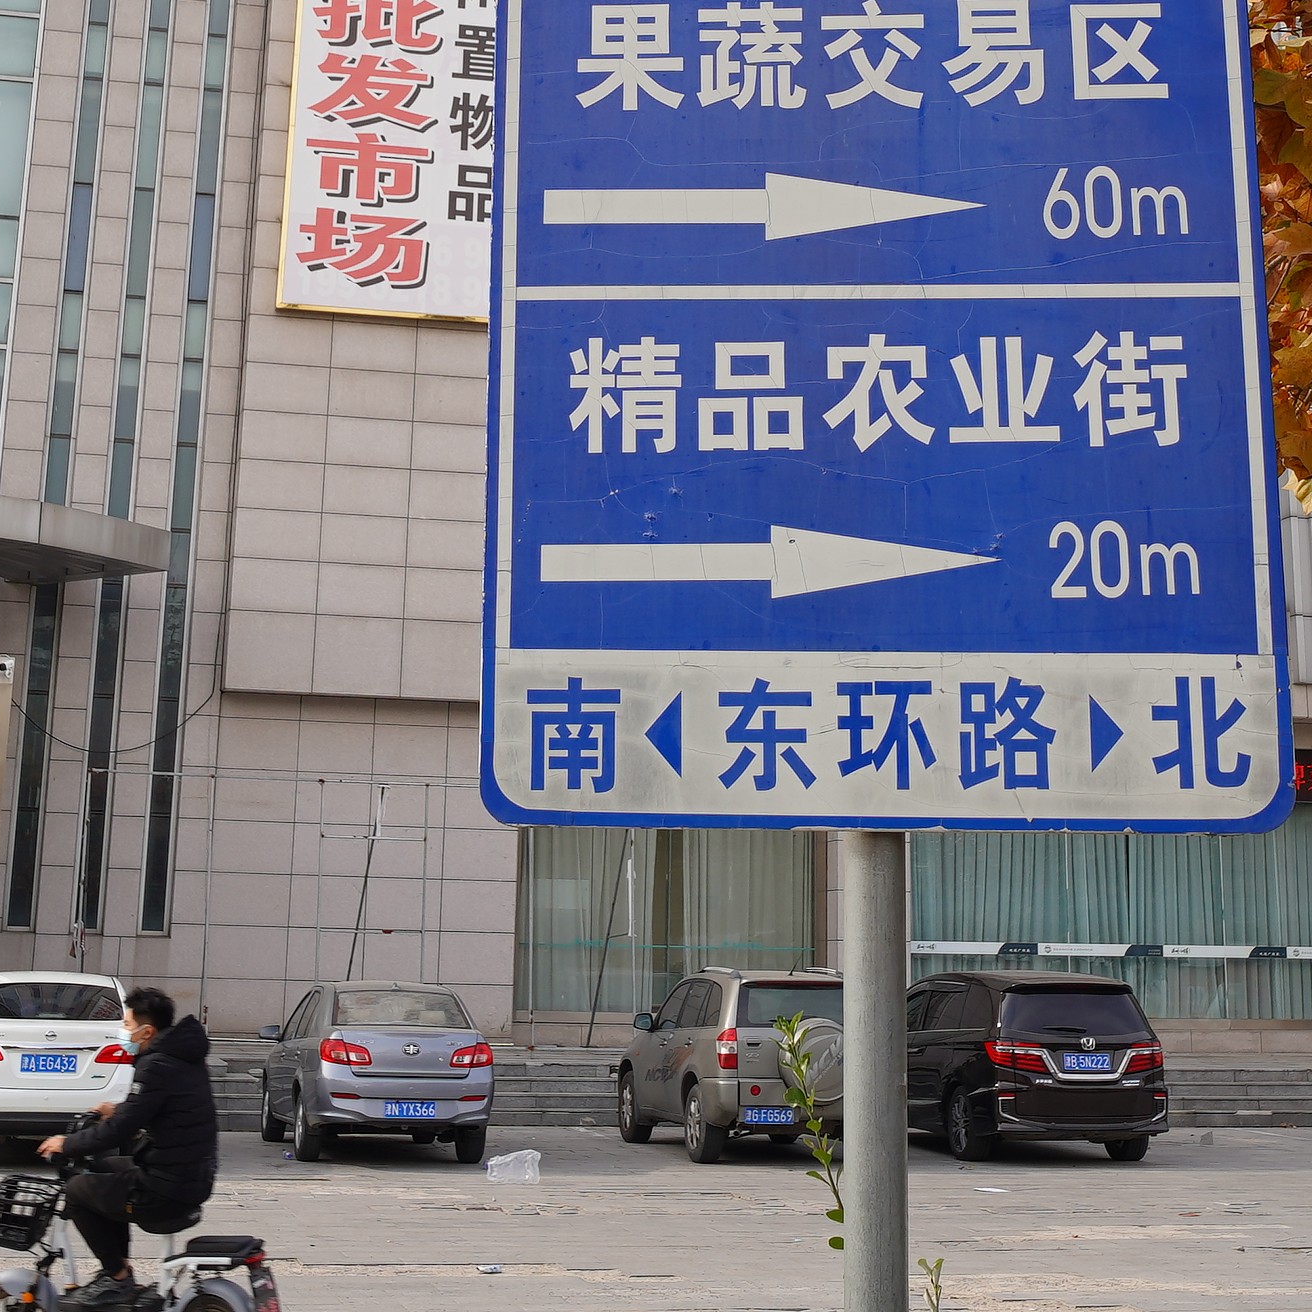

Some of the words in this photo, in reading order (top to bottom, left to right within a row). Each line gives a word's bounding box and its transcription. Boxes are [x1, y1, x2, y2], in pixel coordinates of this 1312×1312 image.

[1042, 165, 1189, 239] 60m
[569, 330, 1187, 453] 精品农业街
[1049, 520, 1201, 599] 20m
[526, 676, 621, 792] 南
[718, 677, 1056, 792] 东环路
[1151, 675, 1252, 791] 北
